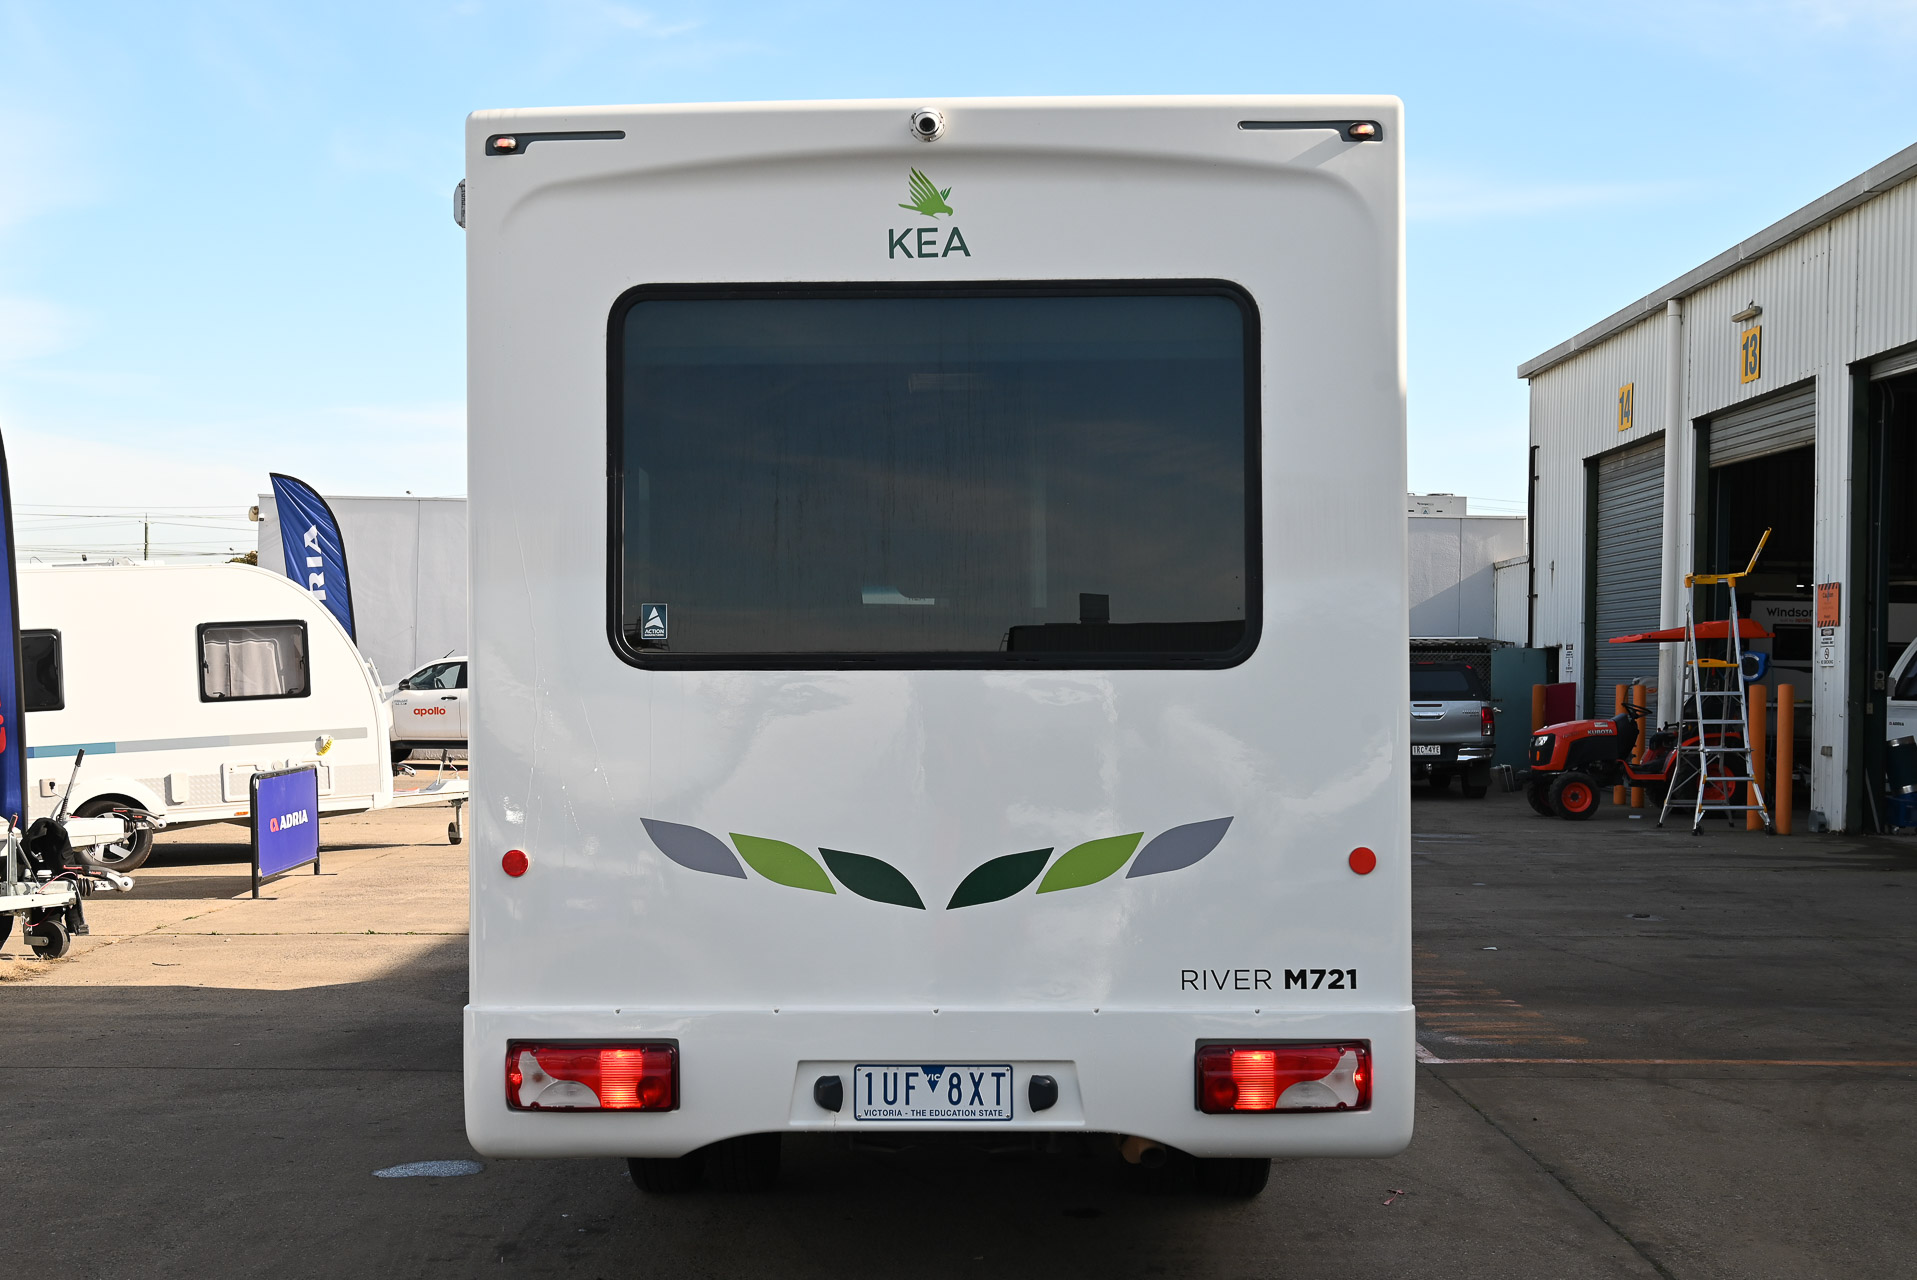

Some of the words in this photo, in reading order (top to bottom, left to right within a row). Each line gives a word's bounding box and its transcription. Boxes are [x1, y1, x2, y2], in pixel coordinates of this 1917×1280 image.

[888, 226, 971, 259] KEA
[1743, 333, 1758, 377] 13
[1619, 389, 1631, 426] 14
[1766, 607, 1813, 617] Windsor
[413, 706, 446, 717] apollo
[280, 809, 309, 831] ADRIA
[1181, 969, 1273, 991] RIVER
[1284, 968, 1358, 990] M721
[864, 1071, 919, 1106] 1UF
[947, 1071, 1006, 1106] 8XT
[924, 1073, 941, 1082] VIC
[863, 1109, 903, 1117] VICTORIA
[911, 1109, 927, 1117] THE
[929, 1109, 976, 1117] EDUCATION
[979, 1109, 1003, 1117] STATE
